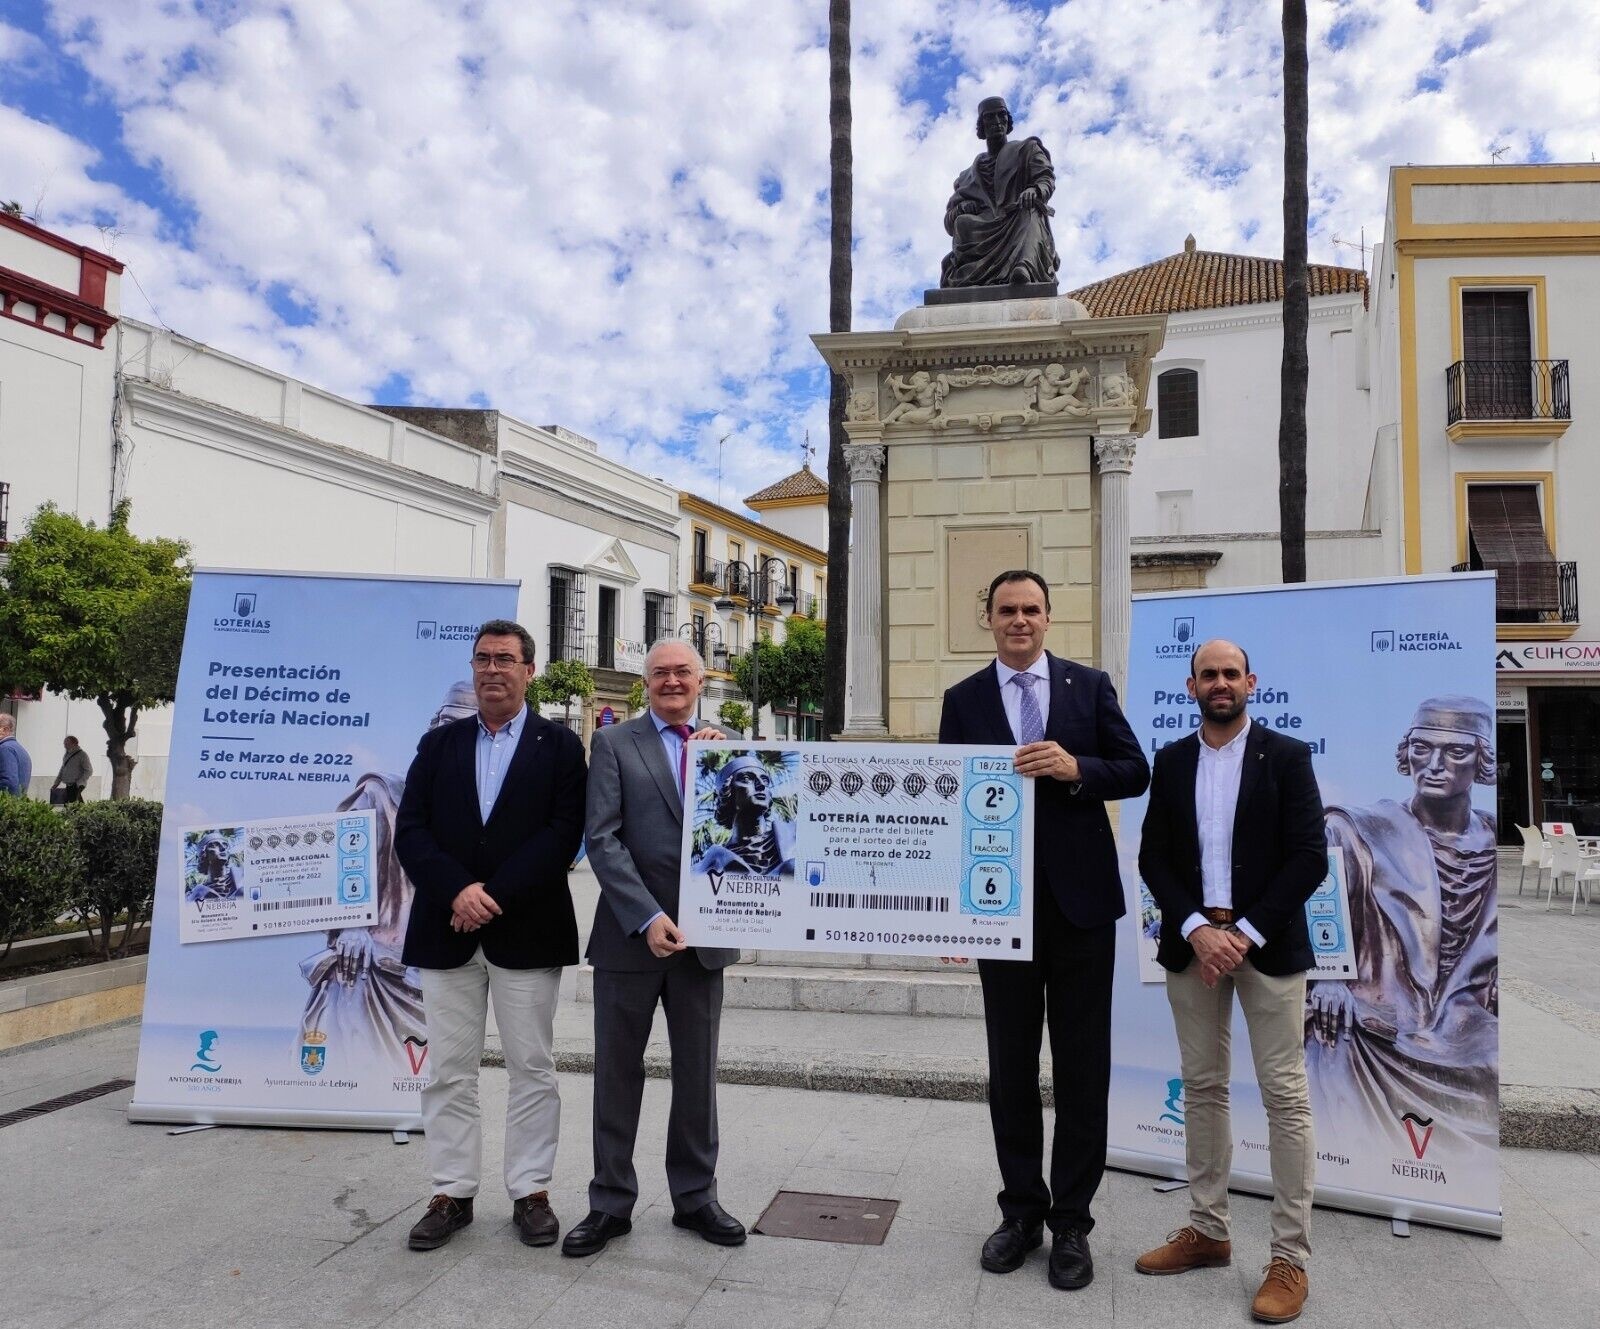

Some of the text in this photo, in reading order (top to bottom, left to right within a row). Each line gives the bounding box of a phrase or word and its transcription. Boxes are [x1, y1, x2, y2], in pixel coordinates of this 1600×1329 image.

[214, 618, 270, 628] LOTERÍAS
[1399, 631, 1449, 641] LOTERÍA
[1155, 643, 1195, 653] LOTERÍ
[1399, 642, 1463, 651] NACIONAL
[1523, 646, 1600, 659] ELIHOM
[208, 661, 341, 681] Presentación
[206, 685, 351, 703] del Décimo de
[203, 708, 370, 727] Lotería Nacional
[1152, 713, 1183, 729] del
[1275, 713, 1302, 729] de
[200, 750, 353, 765] 5 de Marzo de 2022
[822, 754, 858, 764] LOTERÍAS
[868, 756, 910, 765] APUESTAS
[928, 757, 961, 766] ESTADO
[980, 761, 1007, 771] 18/22
[198, 767, 350, 783] AÑO CULTURAL NEBRIJA
[809, 812, 949, 826] LOTERÍA NACIONAL
[859, 826, 884, 835] parte
[887, 826, 901, 834] del
[904, 827, 934, 836] billete
[829, 836, 850, 844] para
[863, 837, 893, 845] sorteo
[895, 837, 910, 845] del
[824, 847, 931, 860] 5 de marzo de 2022
[974, 845, 1009, 853] FRACCIÓN
[250, 853, 331, 866] LOTERÍA NACIONAL
[351, 882, 357, 893] 6
[726, 882, 780, 896] NEBRIJA
[985, 877, 996, 895] 6
[755, 909, 781, 918] Nebrija
[826, 930, 907, 944] 5018201002
[1322, 929, 1329, 940] 6
[264, 1078, 358, 1090] Ayuntamiento de Lebrija
[1136, 1124, 1173, 1136] ANTONIO
[1240, 1139, 1271, 1151] Ayunta
[1316, 1151, 1350, 1165] Lebrija
[1392, 1163, 1447, 1185] NEBRIJA
